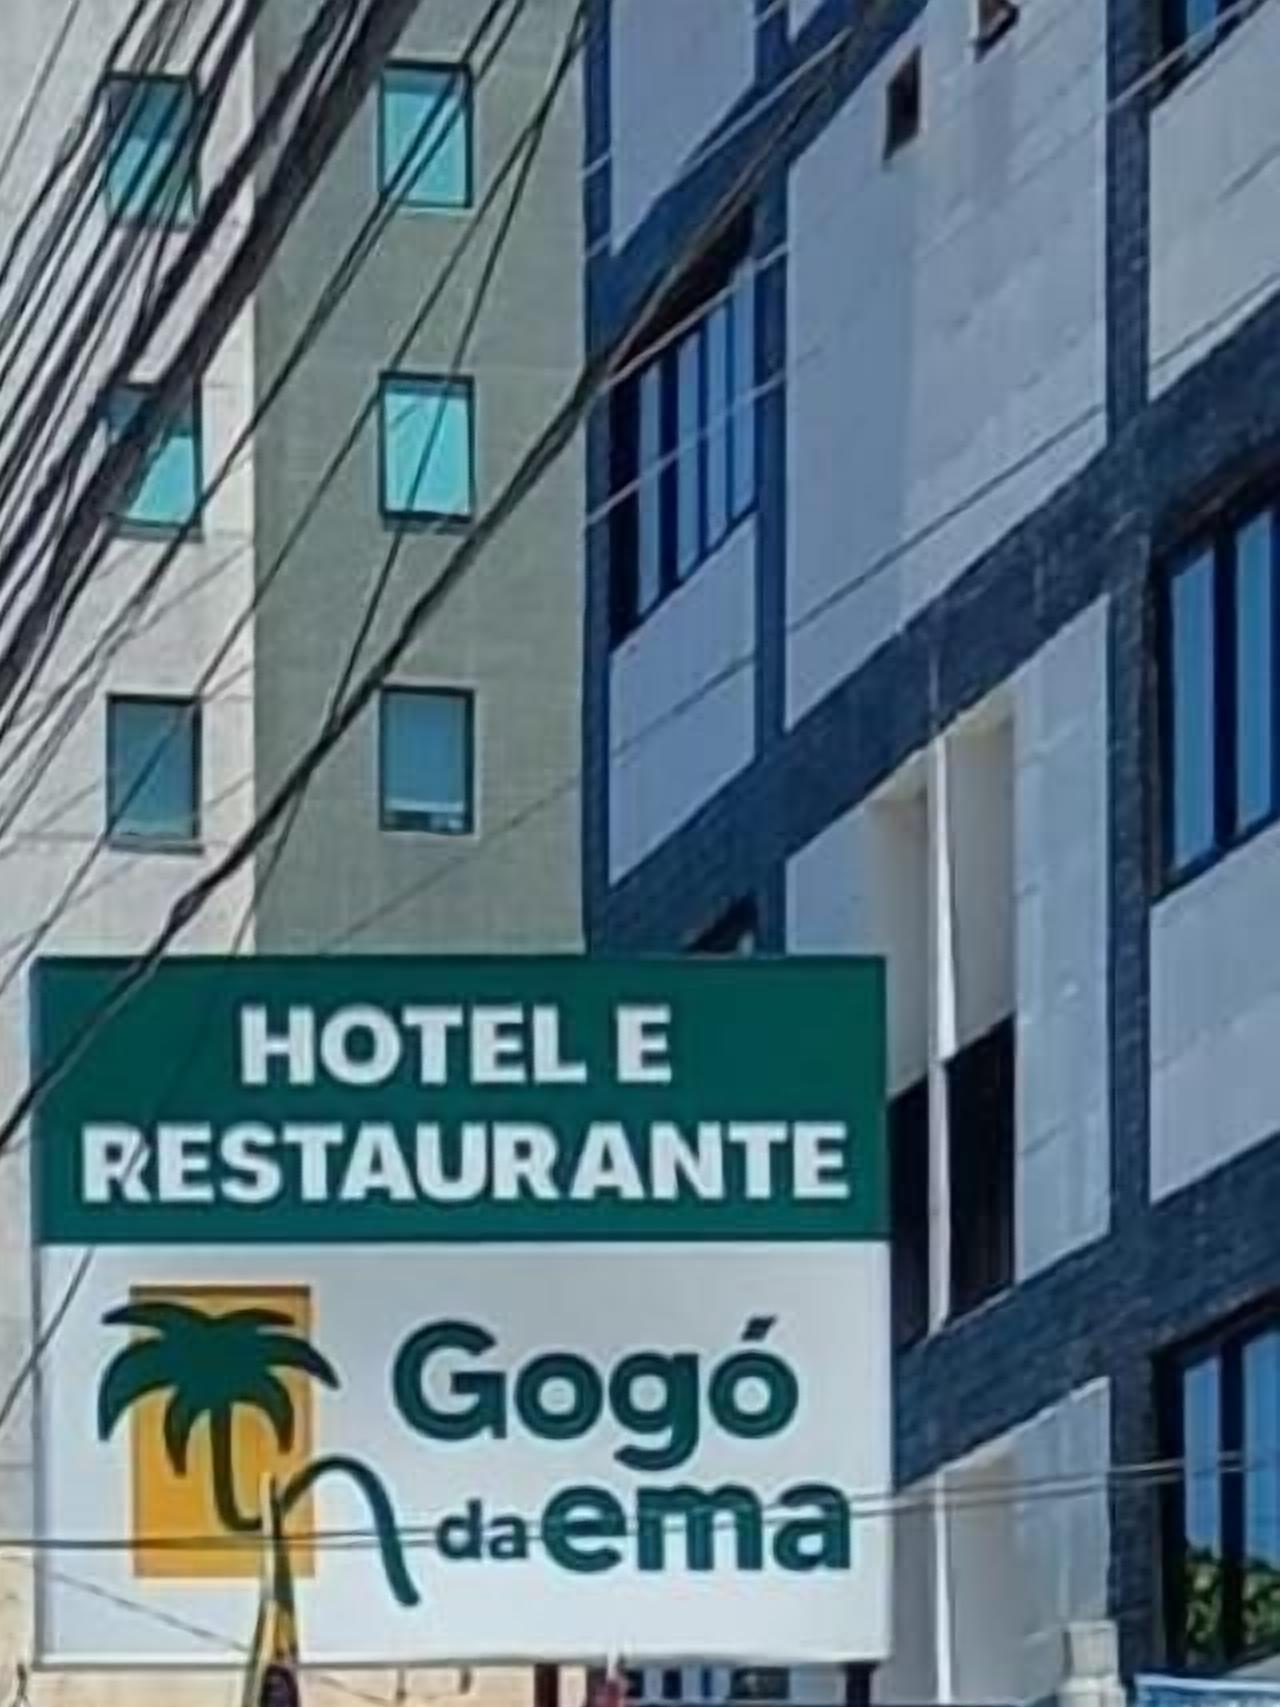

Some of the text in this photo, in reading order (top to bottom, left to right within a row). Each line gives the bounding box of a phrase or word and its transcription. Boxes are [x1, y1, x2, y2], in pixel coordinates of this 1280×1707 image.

[241, 1005, 672, 1084] HOTEL E
[82, 1122, 850, 1202] RESTAURANTE
[391, 1316, 799, 1472] Gogó
[436, 1482, 851, 1573] da ema
